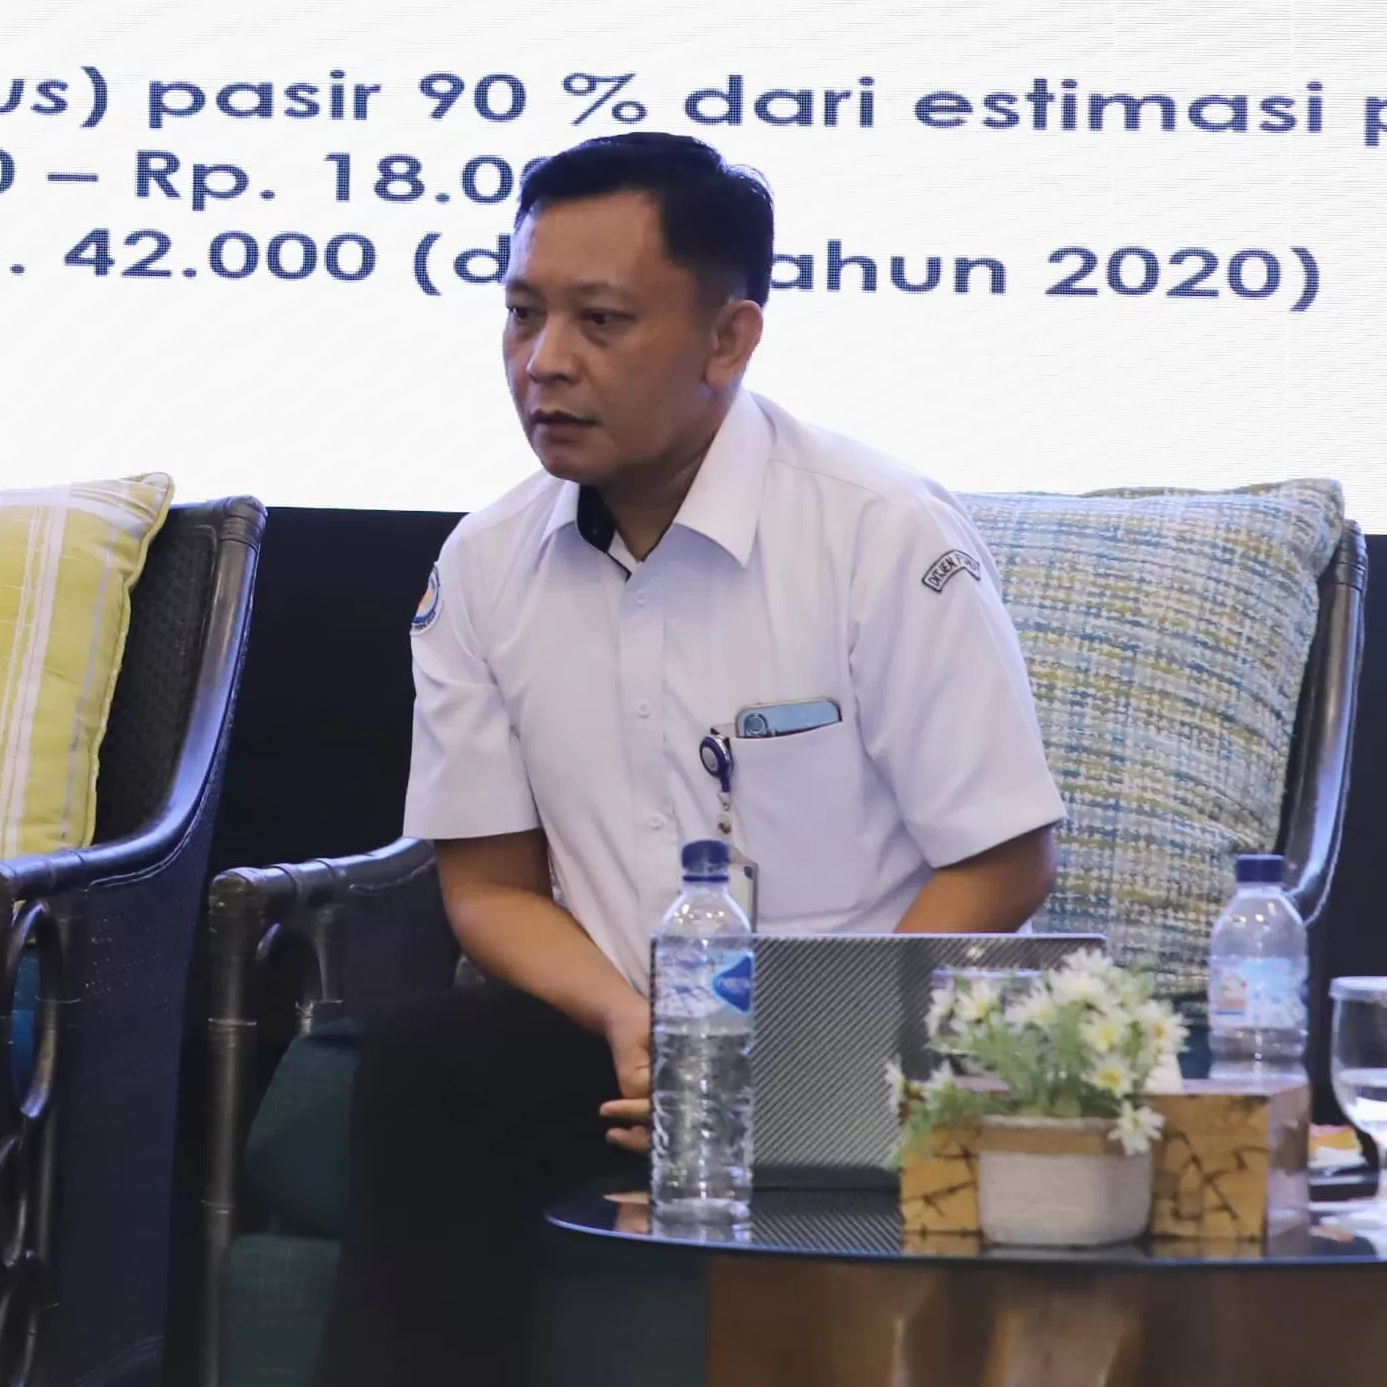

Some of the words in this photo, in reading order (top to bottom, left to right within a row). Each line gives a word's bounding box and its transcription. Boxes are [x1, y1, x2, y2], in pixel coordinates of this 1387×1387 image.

[149, 70, 381, 128] pasir
[419, 73, 526, 122] 90
[563, 73, 647, 126] %
[685, 75, 874, 128] dari
[914, 79, 1323, 133] estimasi
[135, 150, 275, 211] Rp.
[325, 153, 542, 204] 18.0
[64, 228, 376, 280] 42.000
[773, 238, 1006, 295] ahun
[1045, 246, 1319, 311] 2020)
